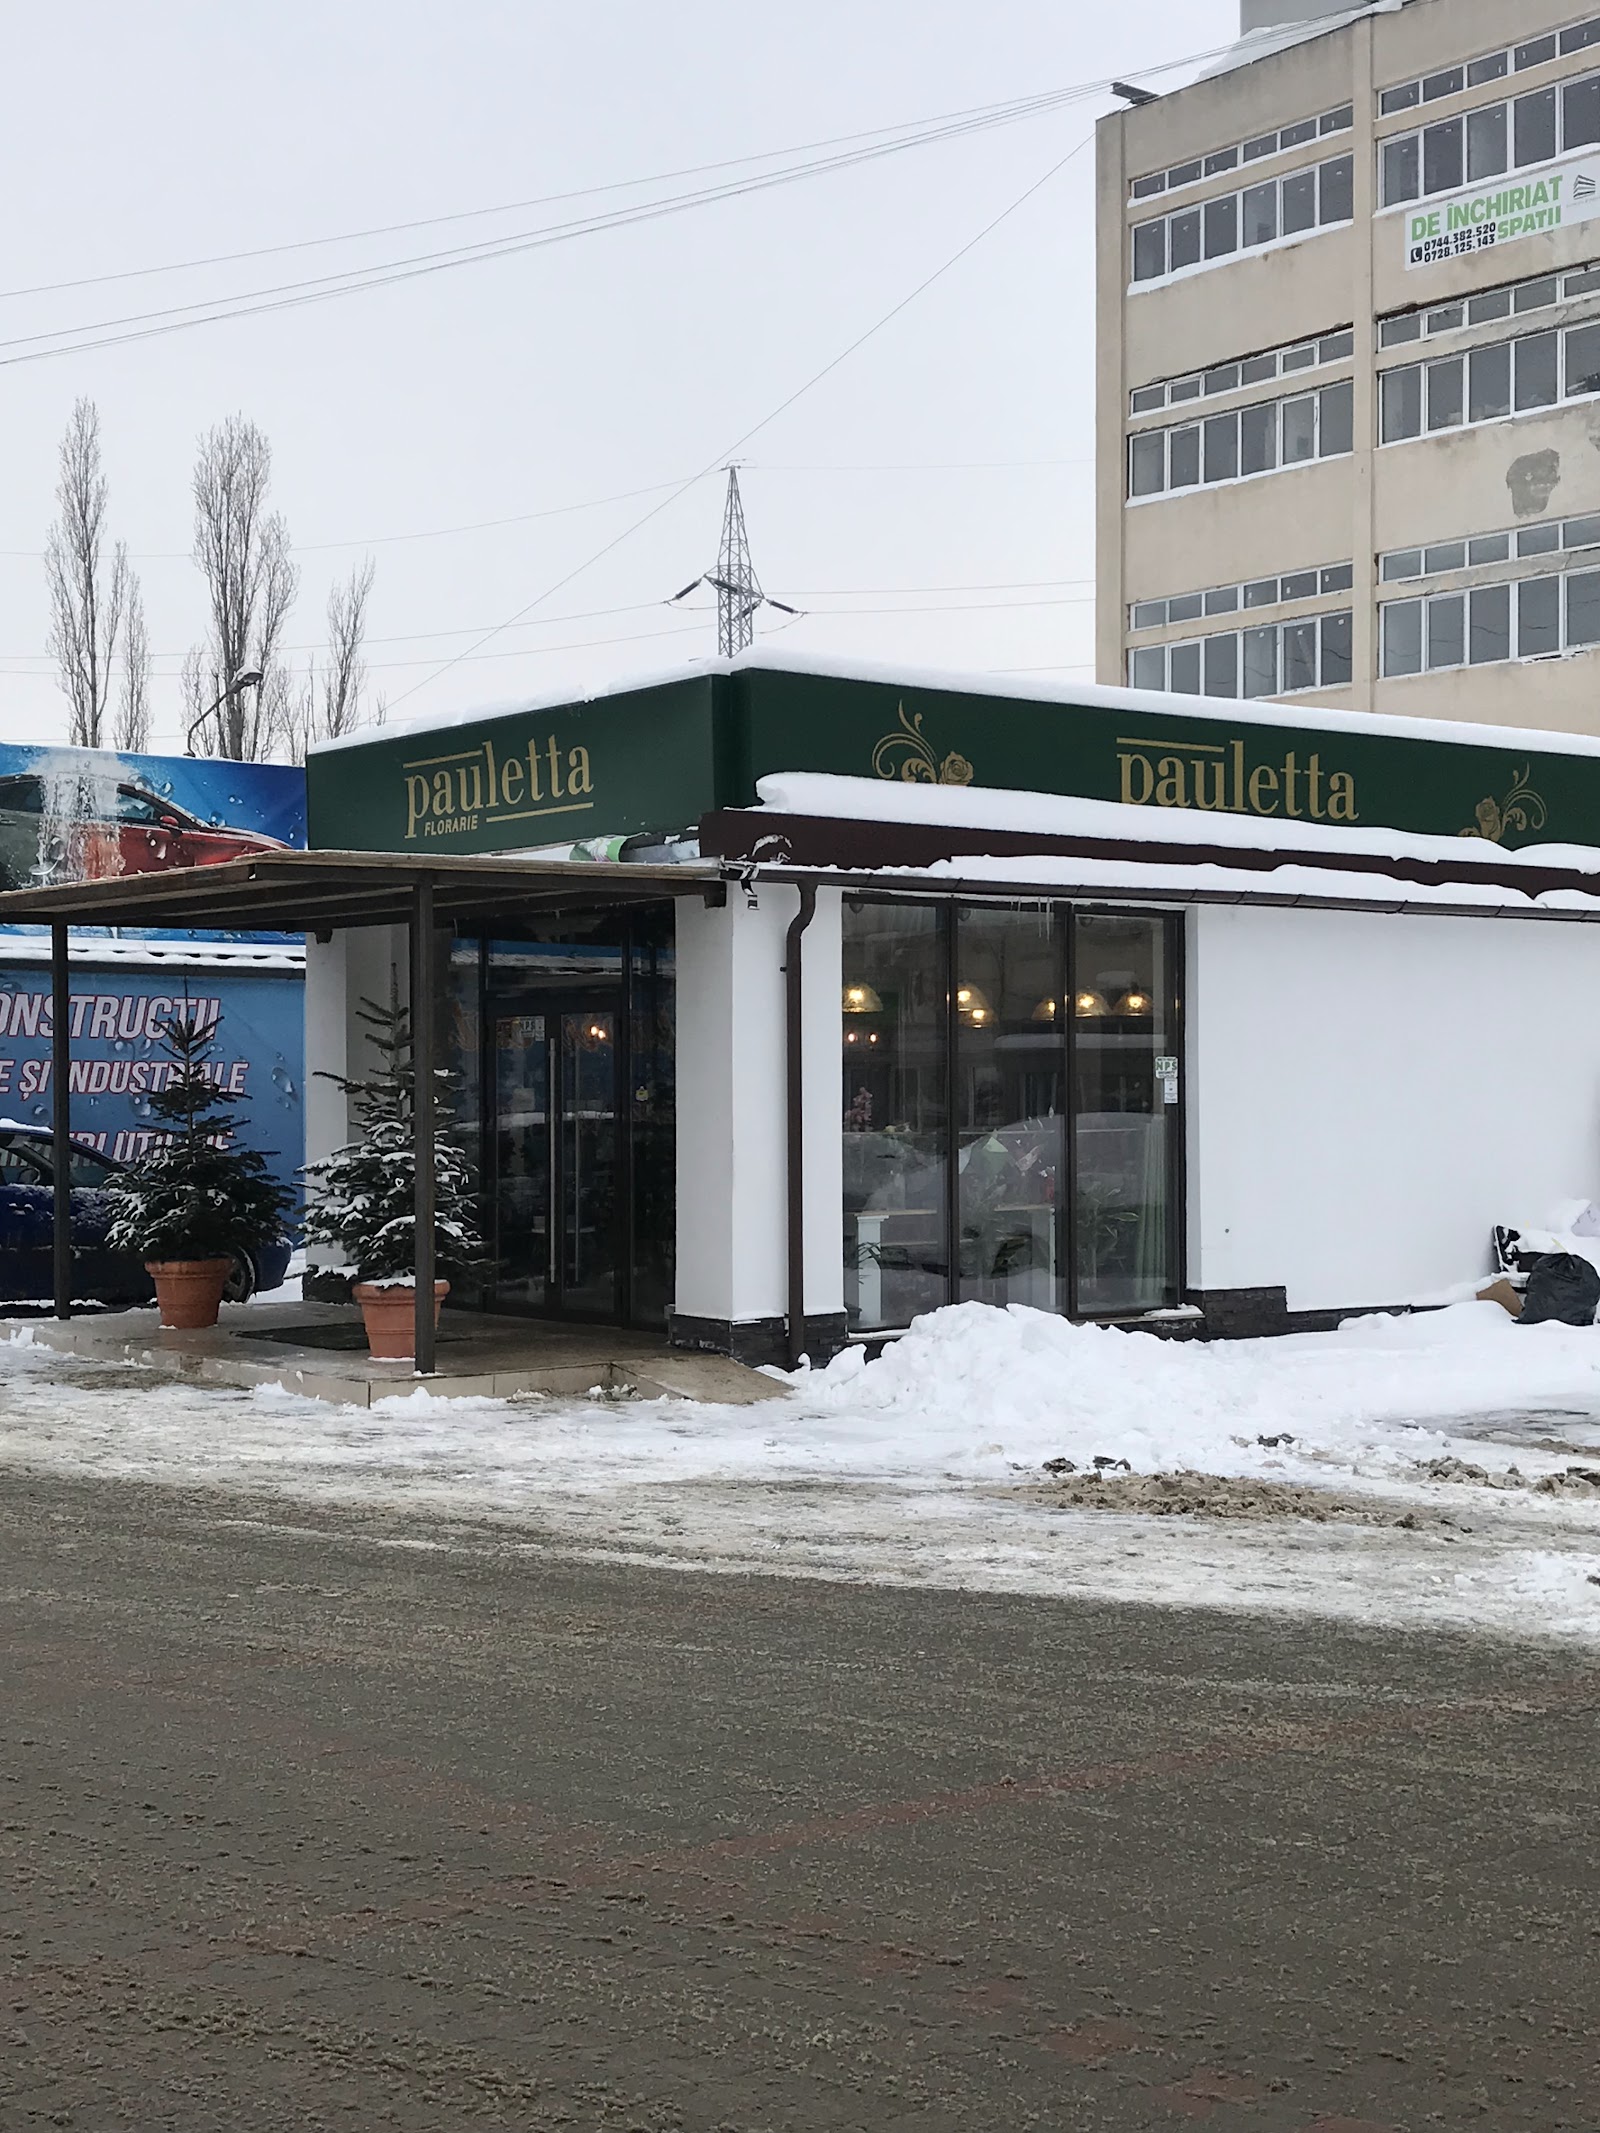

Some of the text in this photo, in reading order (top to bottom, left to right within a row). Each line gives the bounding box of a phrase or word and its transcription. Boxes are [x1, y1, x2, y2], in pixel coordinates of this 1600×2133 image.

[1411, 174, 1563, 242] DE ÎNCHIRIAT
[1498, 205, 1562, 240] SPATII
[1424, 222, 1496, 251] 0744.382.520
[1424, 233, 1496, 263] 0728.125.143
[404, 734, 595, 840] pauletta
[1116, 740, 1360, 821] pauletta
[424, 815, 479, 836] FLORARIE
[18, 1060, 53, 1101] ȘI
[67, 1060, 249, 1095] NDUSTRALE
[1156, 1061, 1177, 1071] NPS
